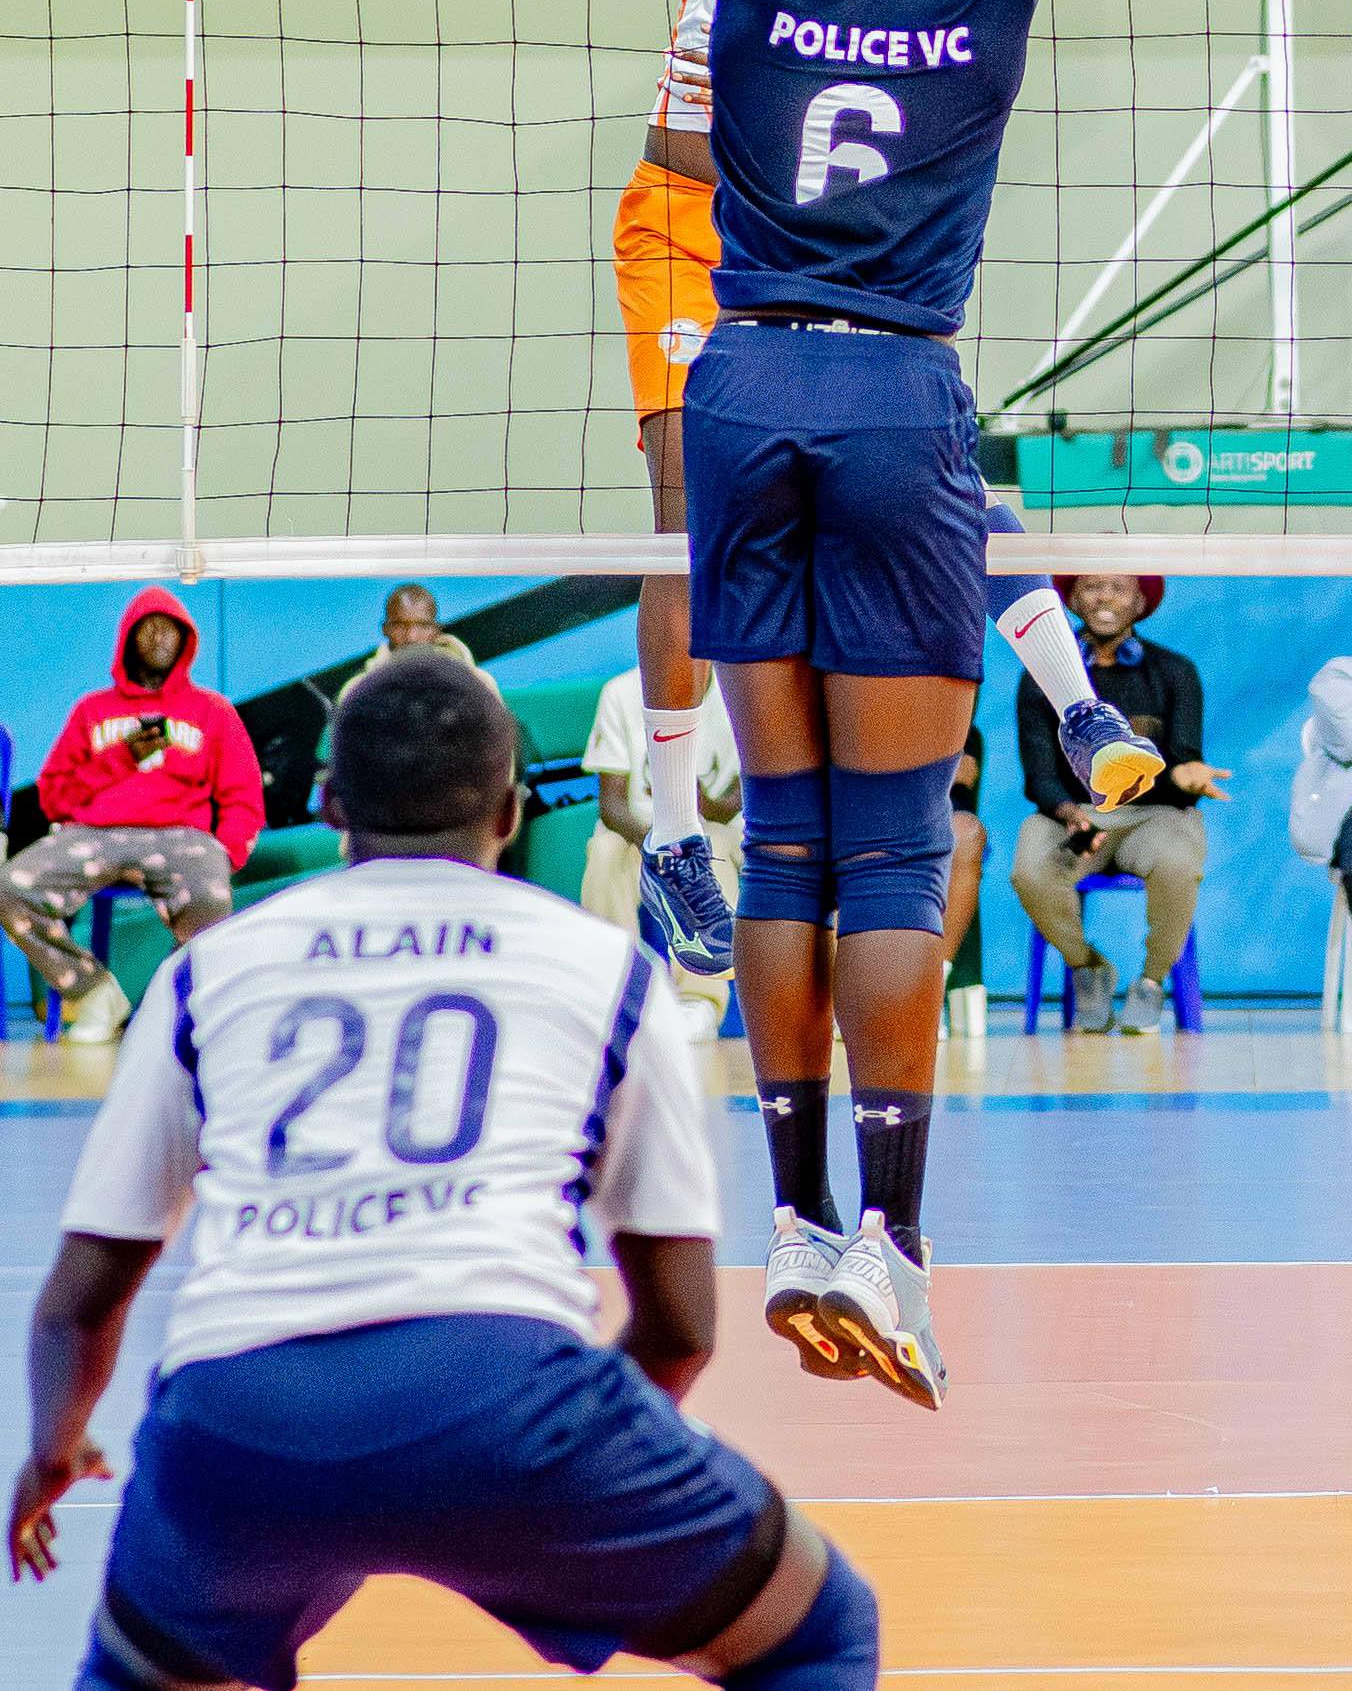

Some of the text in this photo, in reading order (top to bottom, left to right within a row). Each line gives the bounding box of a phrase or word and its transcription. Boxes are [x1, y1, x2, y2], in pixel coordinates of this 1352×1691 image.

[769, 11, 973, 67] POLICE VC
[795, 83, 902, 206] 6
[1210, 451, 1316, 471] ARTISPORT
[307, 921, 498, 960] ALAIN
[266, 993, 500, 1179] 20
